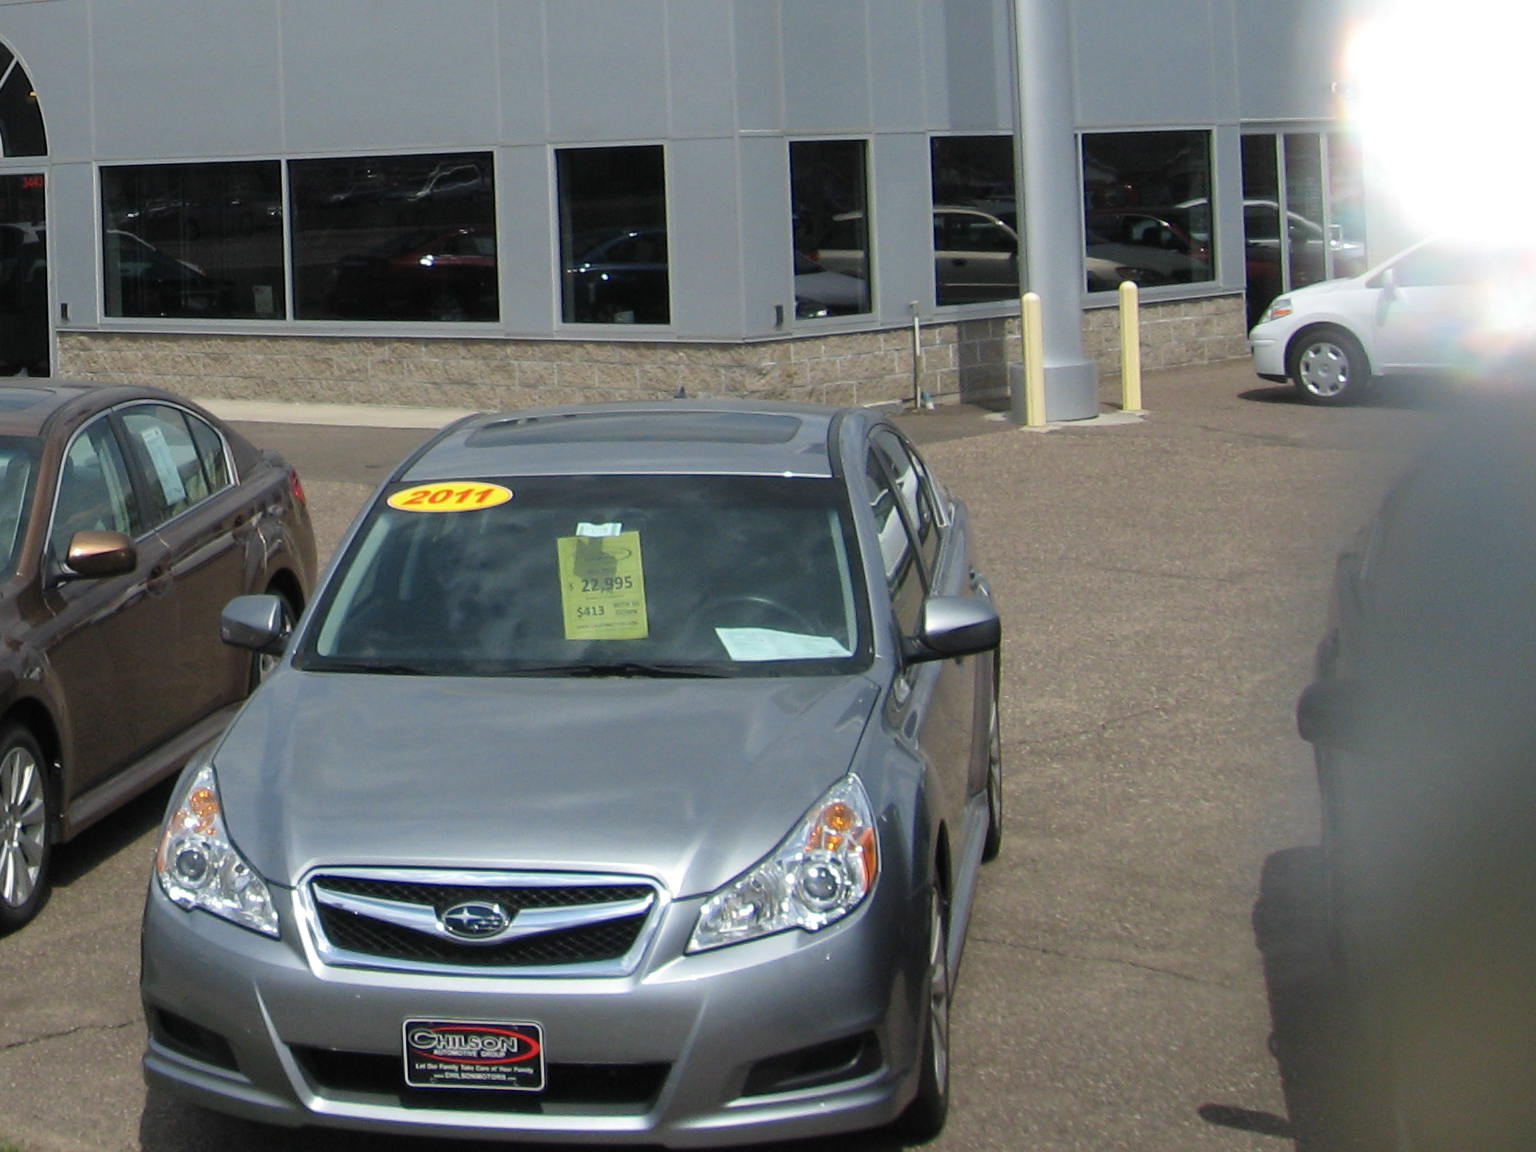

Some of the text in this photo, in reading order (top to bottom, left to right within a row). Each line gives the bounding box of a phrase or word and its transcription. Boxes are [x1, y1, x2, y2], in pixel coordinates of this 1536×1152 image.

[401, 488, 496, 506] 2011
[581, 576, 634, 594] 22,995
[408, 1029, 518, 1052] CHILSON
